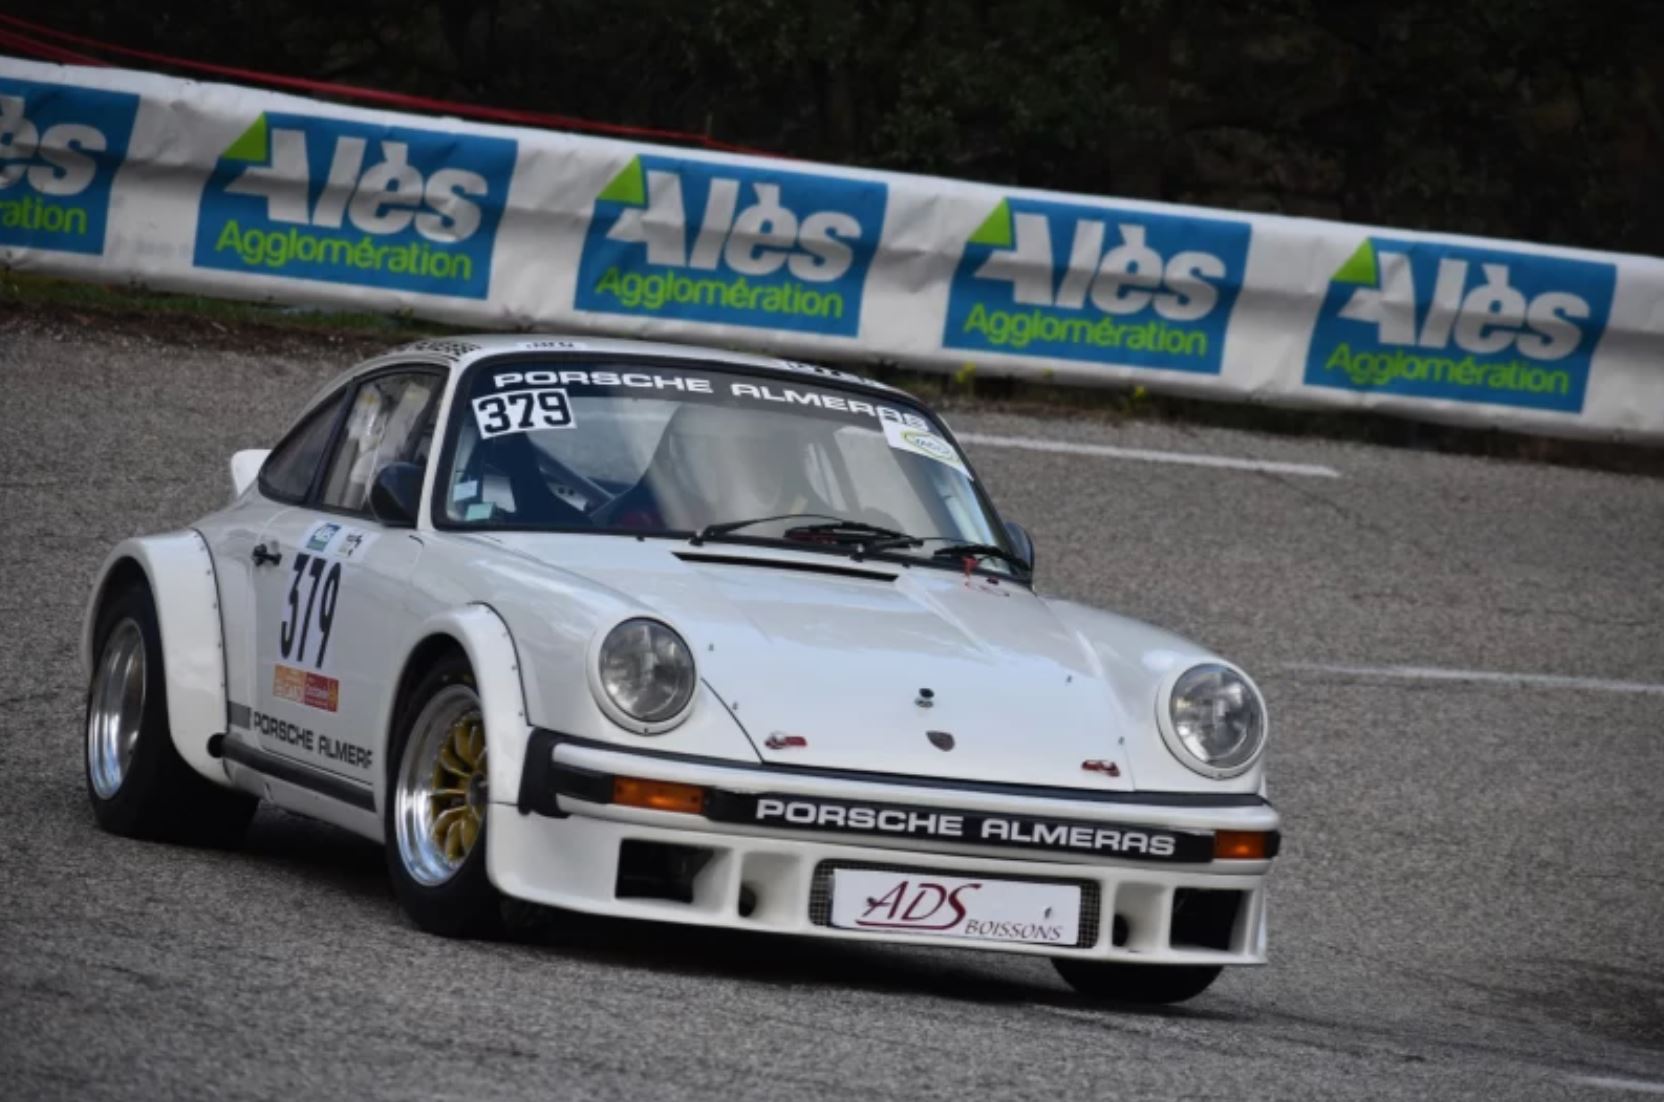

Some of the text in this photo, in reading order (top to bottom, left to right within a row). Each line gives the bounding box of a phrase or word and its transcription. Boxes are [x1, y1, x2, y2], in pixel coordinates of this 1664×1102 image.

[219, 112, 489, 244] Alès
[599, 155, 862, 282] Alès
[215, 219, 472, 281] Agglomération
[967, 198, 1226, 321] Alès
[596, 266, 843, 319] Agglomération
[1330, 238, 1590, 360] Alès
[964, 304, 1208, 355] Agglomération
[493, 371, 713, 394] PORSCHE
[1324, 343, 1569, 394] Agglomération
[477, 391, 572, 434] 379
[280, 553, 341, 669] 379
[254, 711, 314, 750] PORSCHE
[756, 799, 1176, 856] PORSCHE ALMERAS
[858, 880, 981, 929] ADS
[965, 919, 1063, 941] BOISSONS
